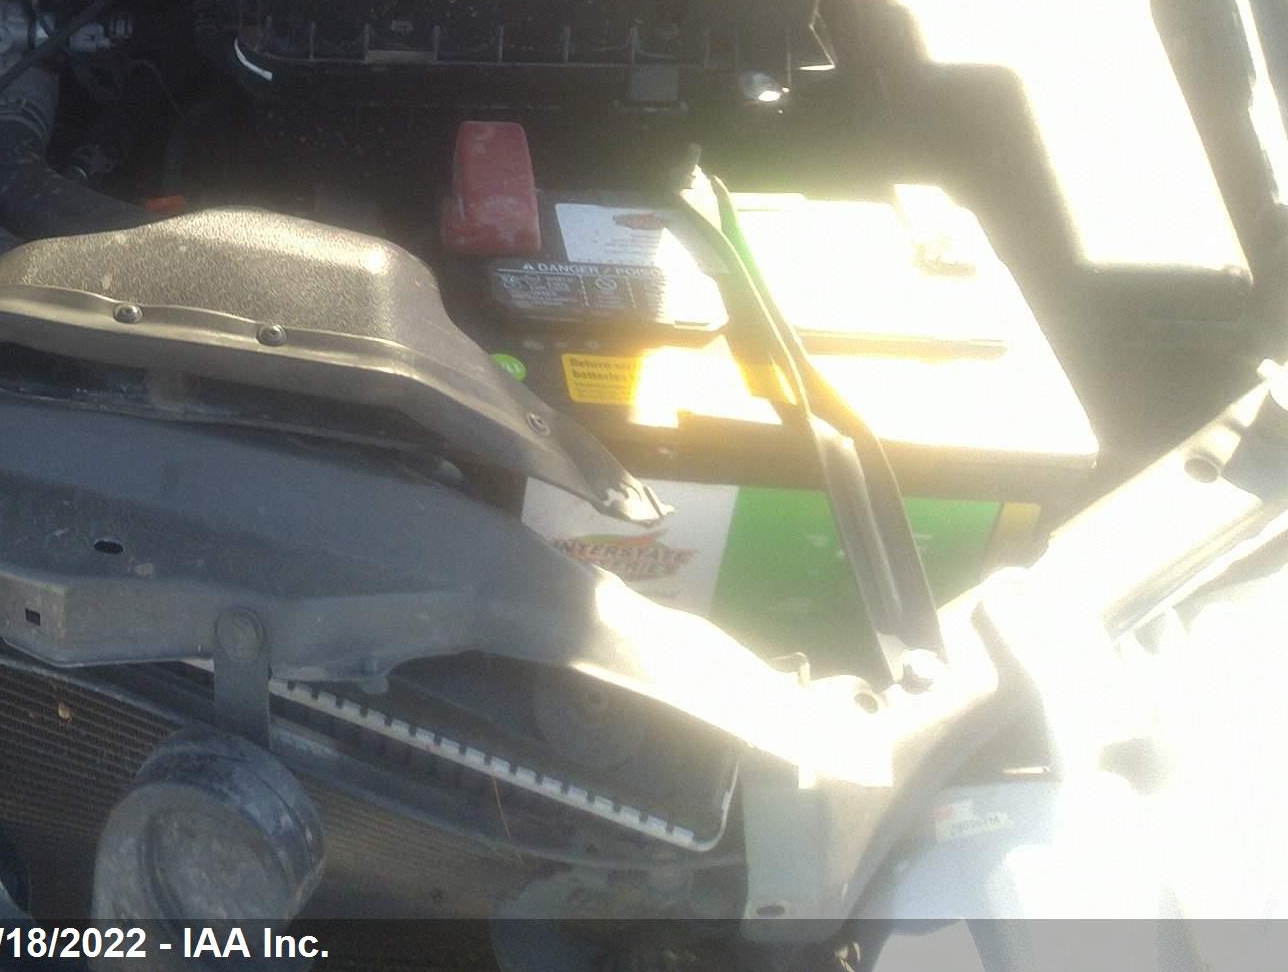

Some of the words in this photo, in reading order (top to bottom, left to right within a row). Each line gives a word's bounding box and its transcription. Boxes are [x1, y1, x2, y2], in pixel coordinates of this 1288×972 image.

[537, 263, 600, 275] DANGER
[615, 267, 664, 277] POISO
[569, 357, 612, 371] Return
